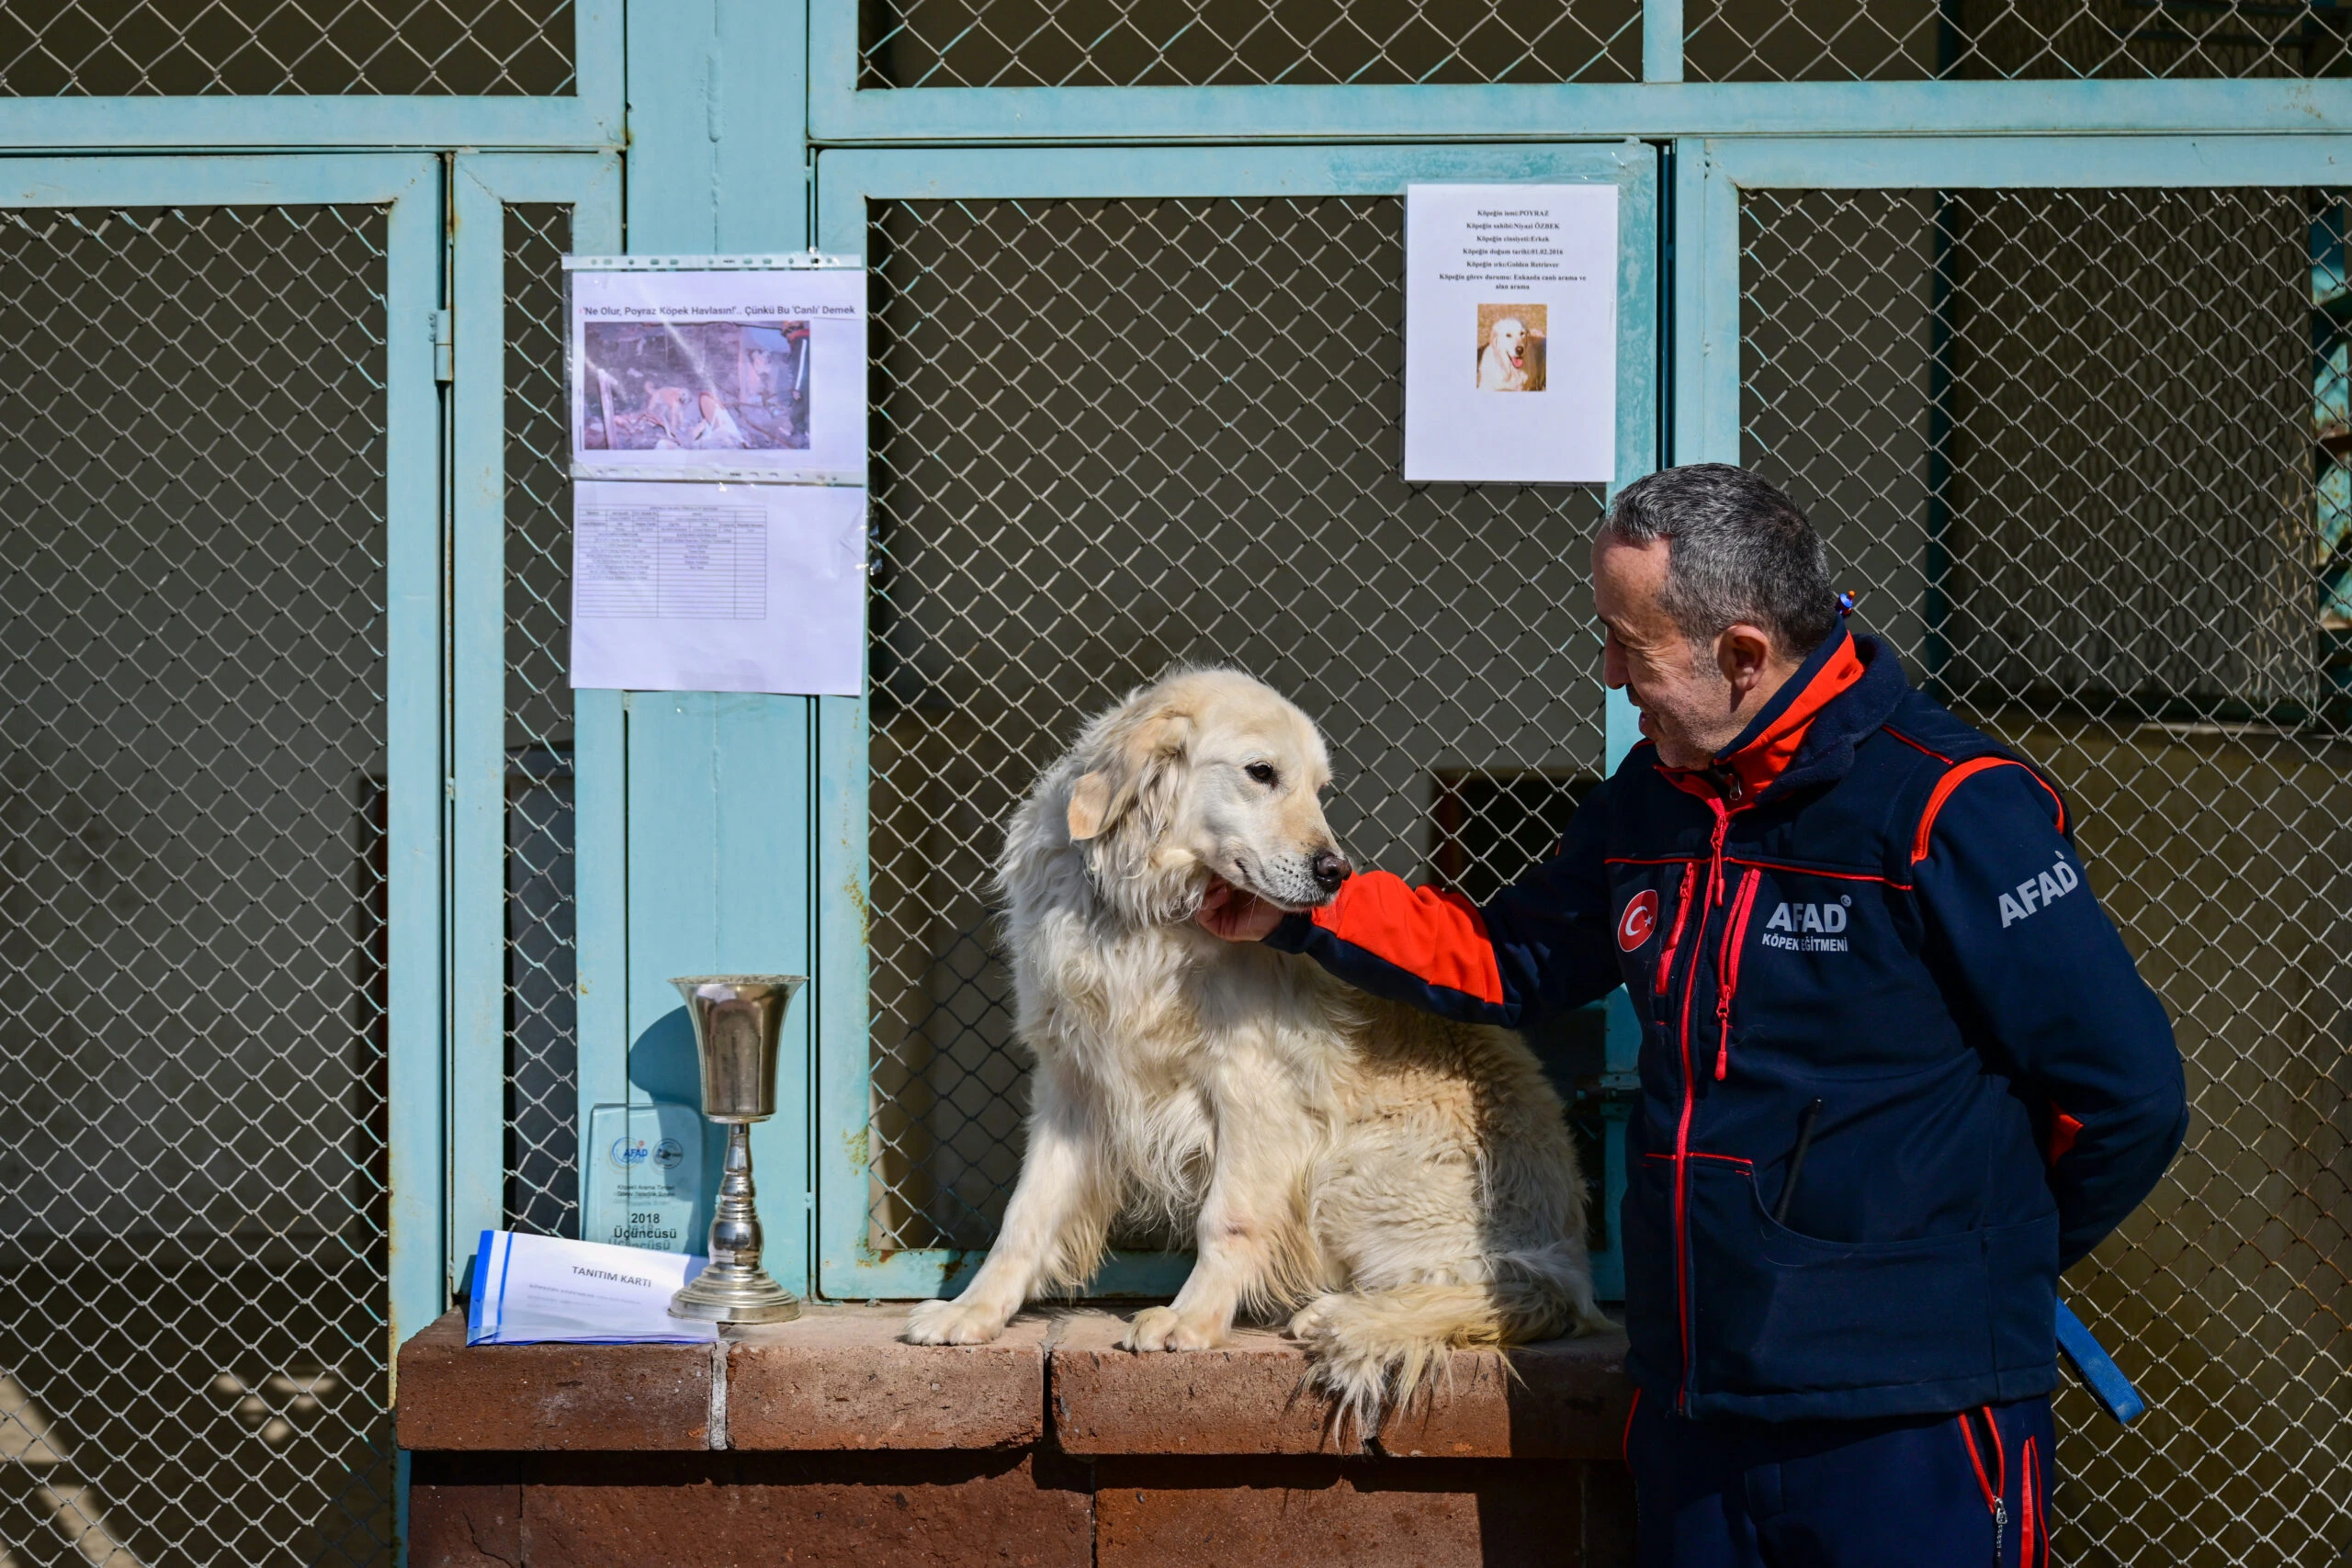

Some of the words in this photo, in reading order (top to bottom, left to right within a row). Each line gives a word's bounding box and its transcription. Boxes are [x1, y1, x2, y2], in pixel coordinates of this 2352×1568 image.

[600, 306, 622, 317] Olur,
[625, 307, 656, 318] Poyraz
[660, 306, 689, 317] Köpek
[744, 305, 775, 317] Çünkü
[777, 305, 790, 315] Bu
[822, 305, 856, 315] Demek
[1998, 861, 2078, 929] AFAD
[1766, 902, 1847, 933] AFAD
[1762, 933, 1800, 951] KÖPEK
[1801, 936, 1849, 952] EĞİTMENİ
[623, 1148, 649, 1158] AFAD
[631, 1213, 661, 1224] 2018
[614, 1224, 677, 1241] Üçüncüsü
[571, 1266, 618, 1281] TANITIM
[620, 1274, 652, 1288] KARTI
